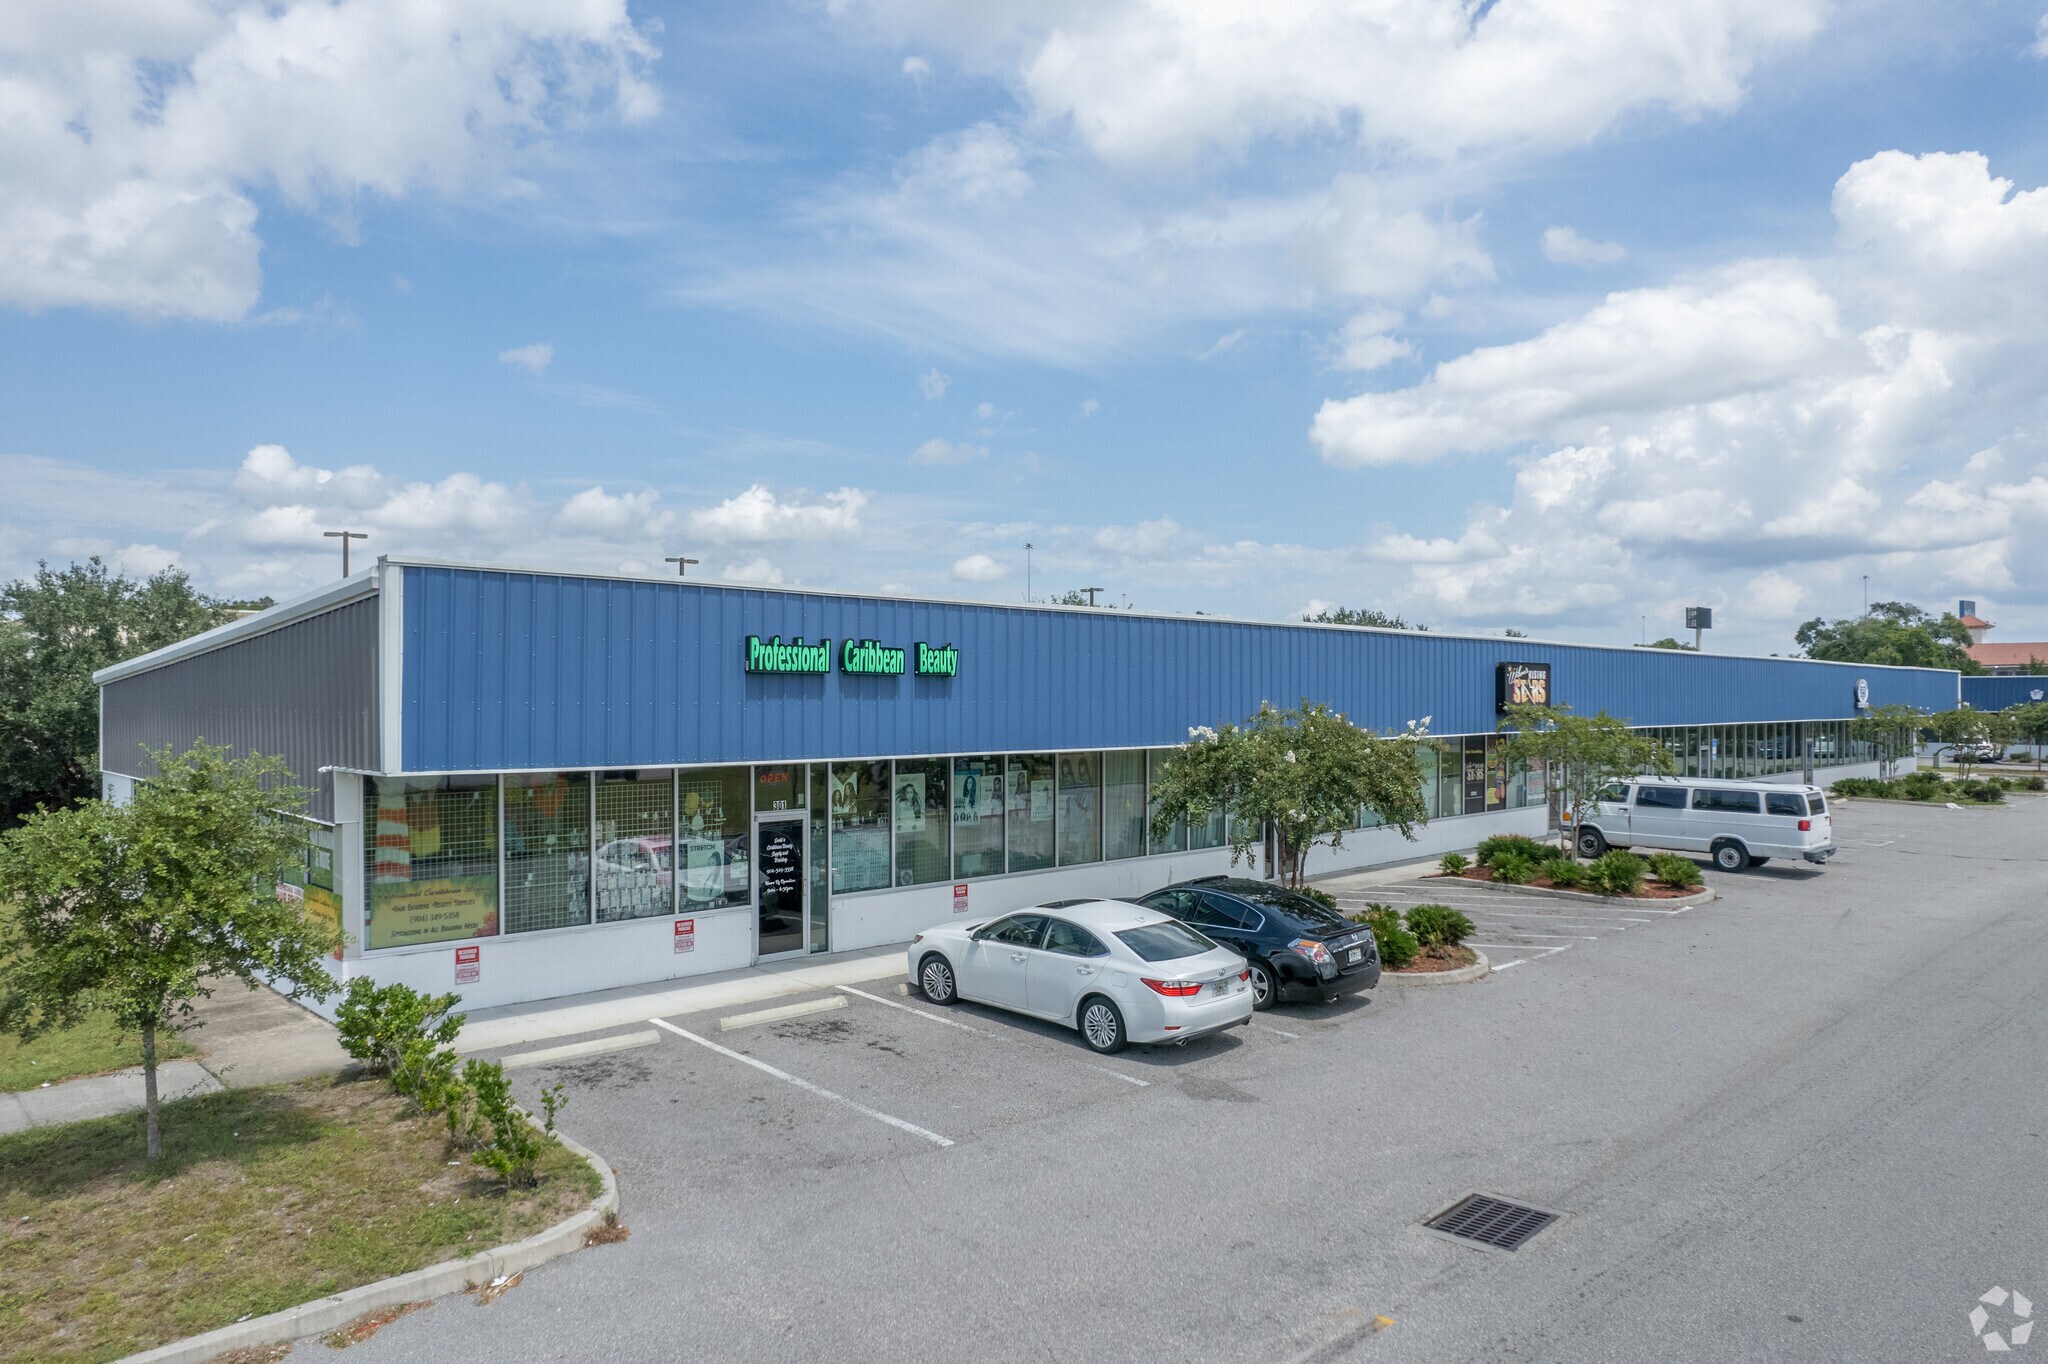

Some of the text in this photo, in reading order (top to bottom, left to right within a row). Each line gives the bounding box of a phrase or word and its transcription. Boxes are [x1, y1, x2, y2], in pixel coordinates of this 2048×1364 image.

[749, 636, 959, 677] Professional Caribbean Beauty
[760, 772, 789, 784] OPEN
[773, 800, 787, 810] 301
[690, 844, 716, 852] STRETCH
